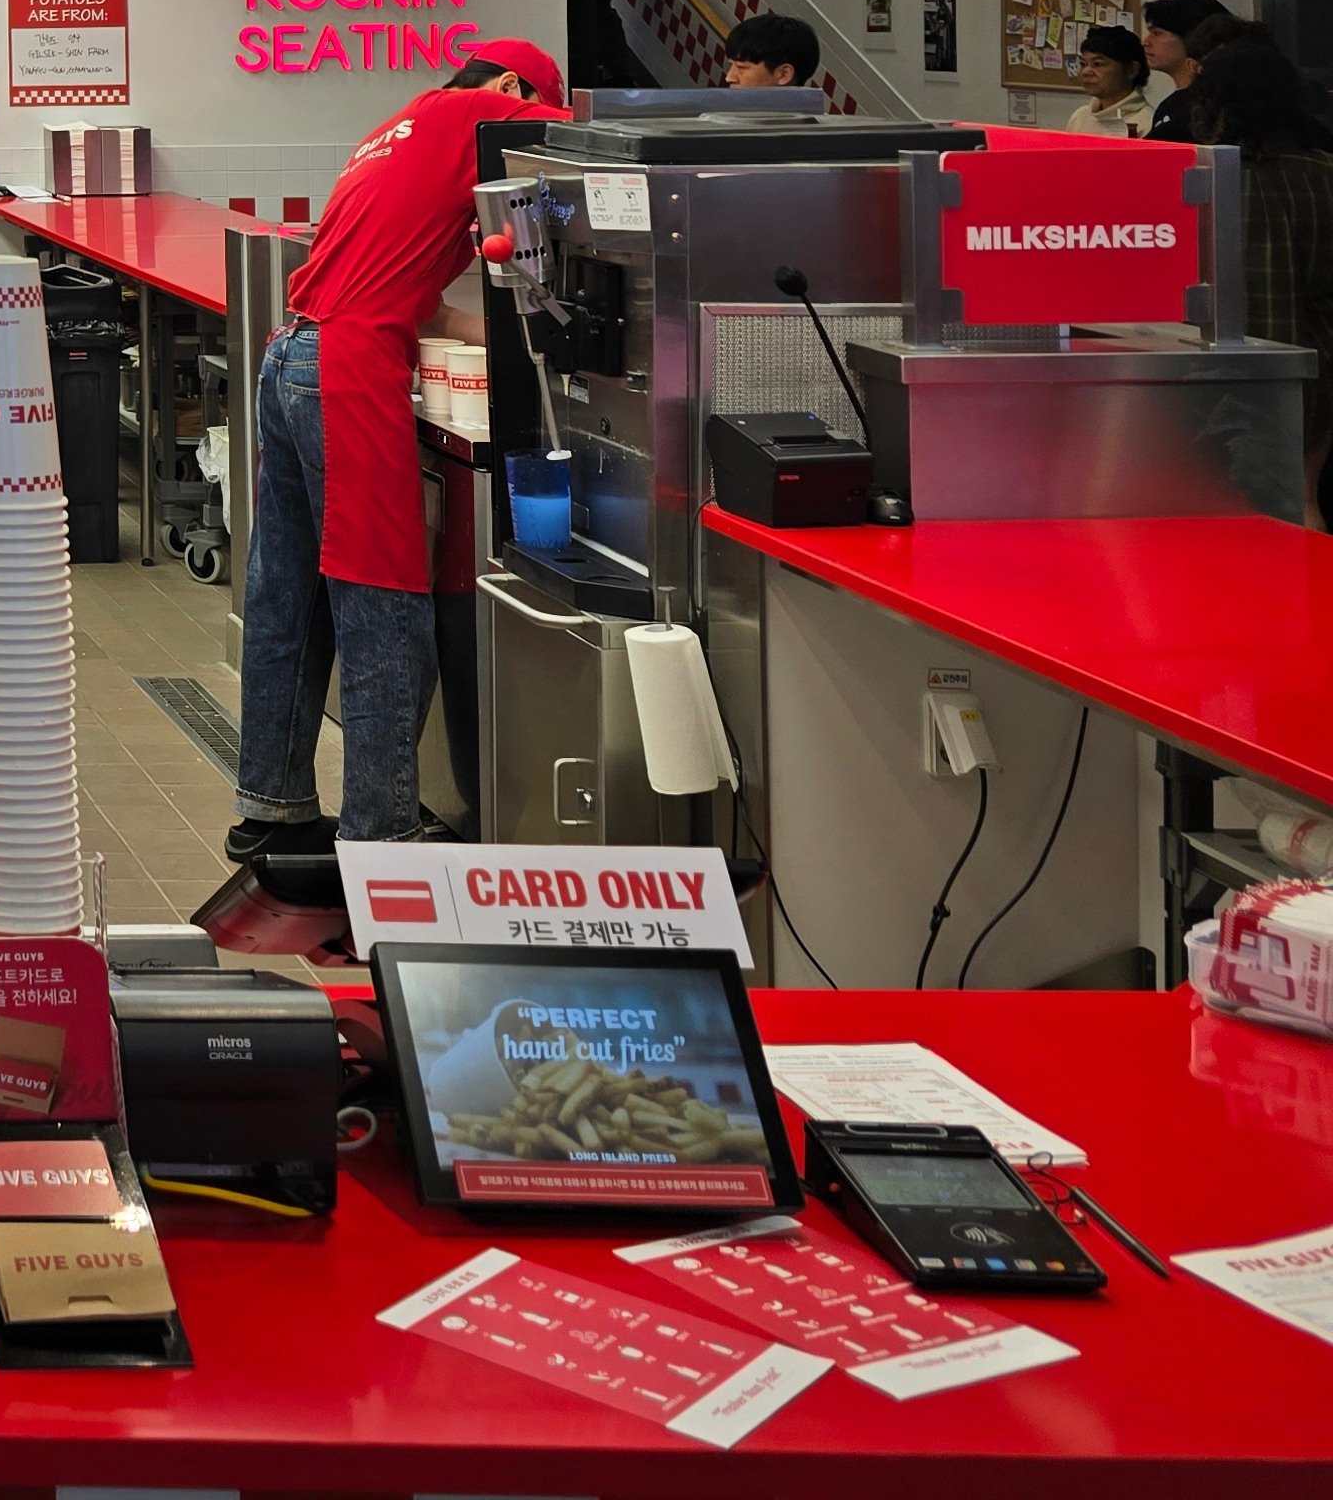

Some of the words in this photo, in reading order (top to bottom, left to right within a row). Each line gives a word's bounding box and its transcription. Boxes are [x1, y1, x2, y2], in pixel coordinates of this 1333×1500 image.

[28, 10, 59, 22] ARE
[62, 8, 109, 21] FROM:
[236, 22, 481, 73] SEATING
[966, 223, 1177, 251] MILKSHAKES
[454, 380, 476, 388] FIVE
[9, 402, 54, 424] FIVE
[466, 868, 587, 907] CARD
[598, 870, 704, 910] ONLY
[508, 919, 557, 945] 카드
[564, 920, 633, 946] 결제만
[642, 922, 690, 947] 가능
[14, 953, 44, 962] GUYS
[12, 988, 76, 1006] 전하세요!
[207, 1035, 251, 1048] micros
[503, 1033, 569, 1062] hand
[576, 1037, 615, 1062] cut
[209, 1052, 252, 1060] ORACLE
[16, 1077, 47, 1091] GUYS
[569, 1151, 599, 1163] LONG
[601, 1152, 640, 1164] ISLAND
[642, 1153, 677, 1164] PRESS
[42, 1168, 110, 1187] GUYS
[14, 1255, 69, 1273] FIVE
[76, 1253, 144, 1269] GUYS
